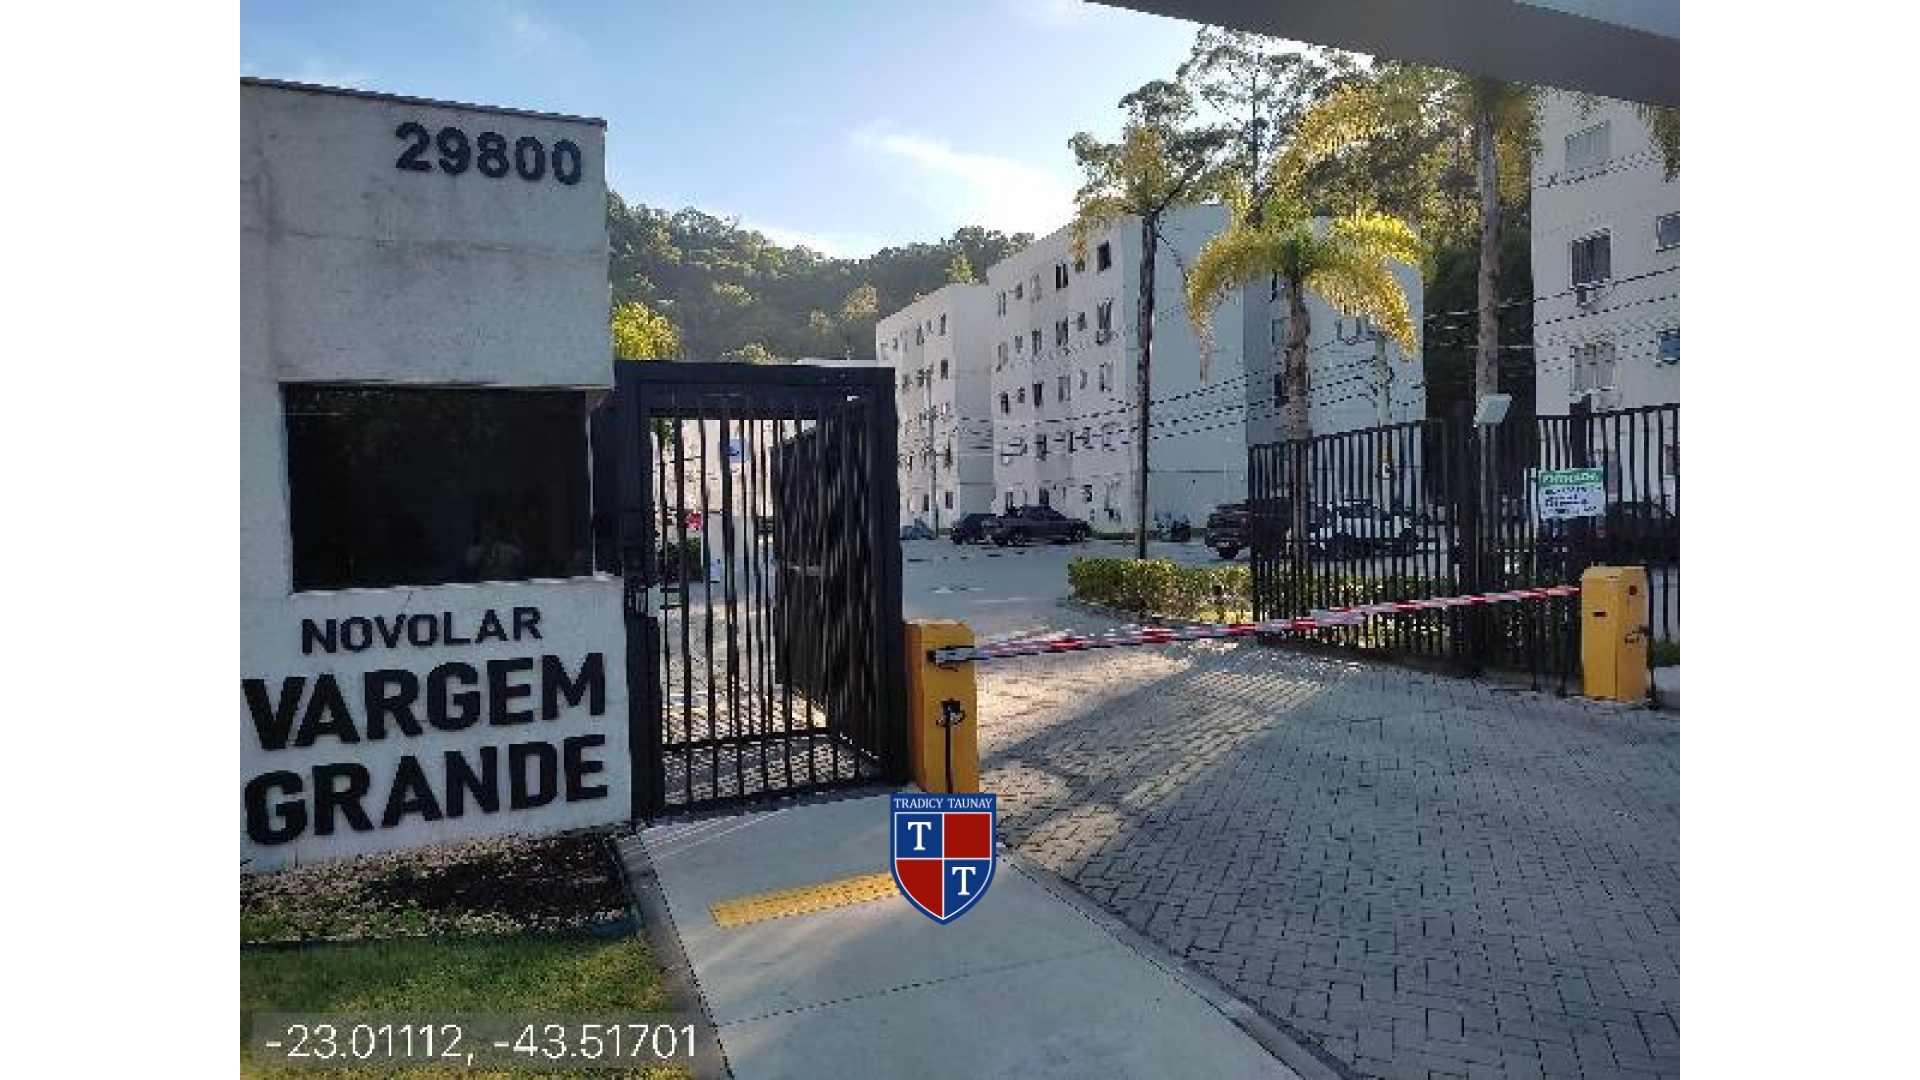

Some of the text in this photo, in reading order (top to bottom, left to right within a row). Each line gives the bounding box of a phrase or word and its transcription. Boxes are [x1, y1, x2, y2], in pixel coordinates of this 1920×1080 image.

[396, 120, 582, 185] 29800
[301, 606, 542, 655] NOVOLAR
[241, 652, 606, 750] VARGEM
[244, 734, 608, 845] GRANDE
